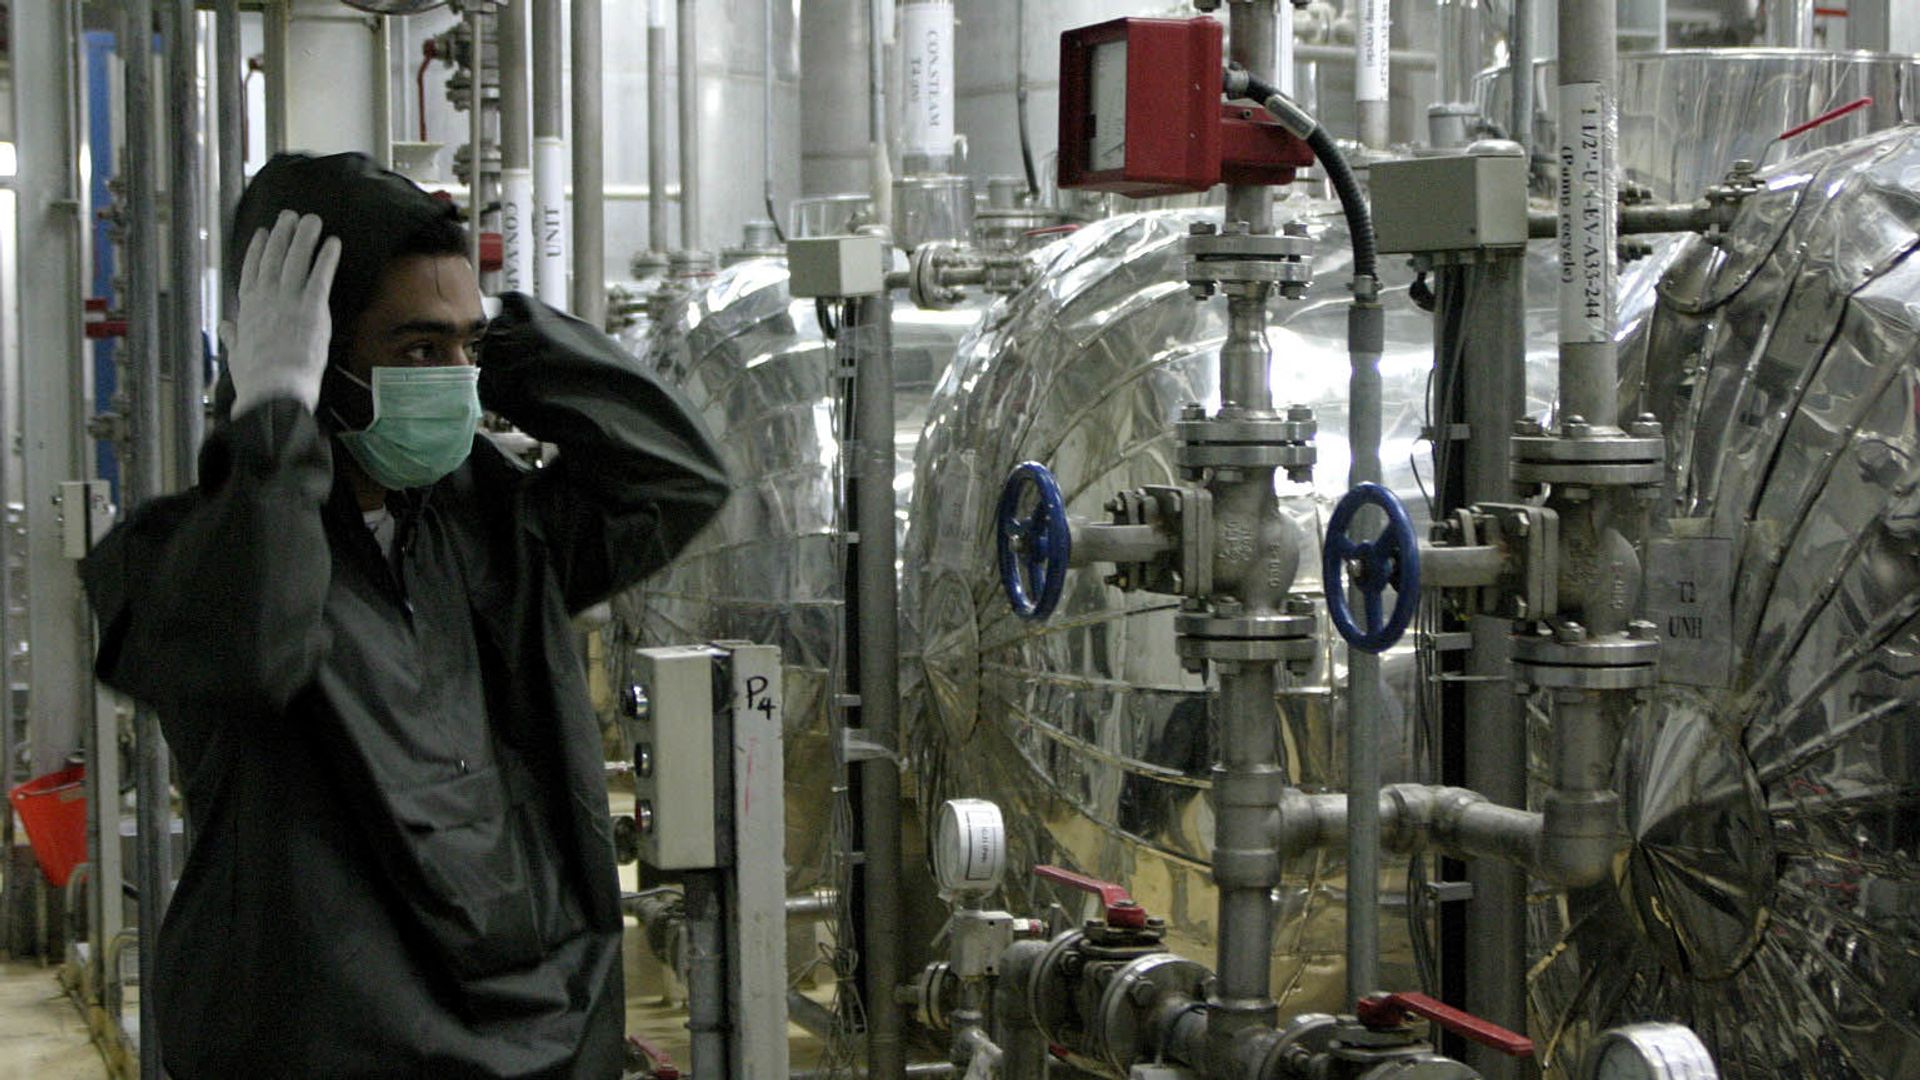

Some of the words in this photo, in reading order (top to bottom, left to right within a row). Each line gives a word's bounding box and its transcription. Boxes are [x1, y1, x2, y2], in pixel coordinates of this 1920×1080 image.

[1559, 146, 1575, 207] (Pump
[544, 205, 561, 257] UNIT
[1559, 214, 1577, 284] recycle)
[747, 676, 776, 720] P4
